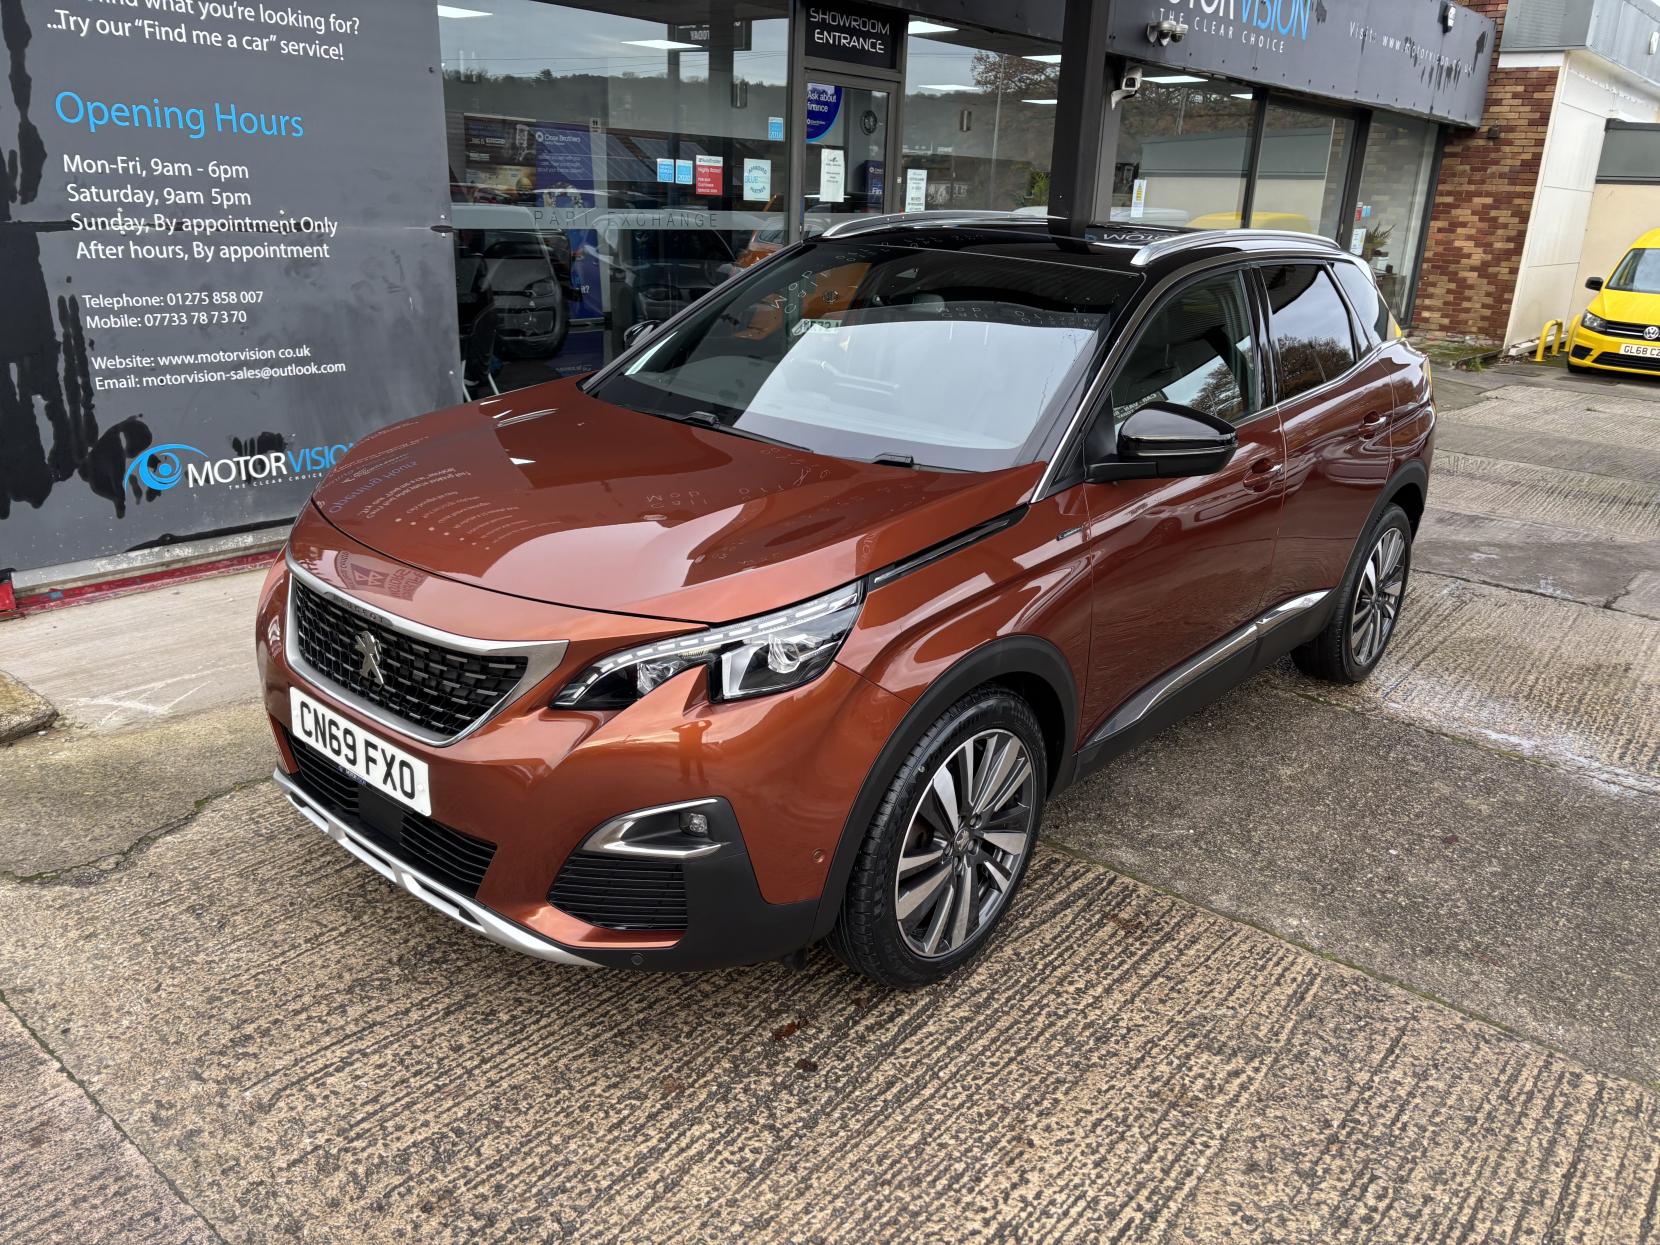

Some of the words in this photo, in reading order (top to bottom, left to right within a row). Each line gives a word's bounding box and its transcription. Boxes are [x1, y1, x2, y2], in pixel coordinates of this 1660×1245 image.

[198, 0, 255, 21] you're
[259, 3, 325, 35] looking
[329, 13, 360, 35] for?
[809, 7, 890, 36] SHOWROOM
[46, 9, 90, 37] ...Try
[95, 19, 131, 37] our
[134, 18, 187, 43] "Find
[192, 30, 222, 47] me
[227, 34, 237, 48] a
[242, 34, 276, 51] car"
[280, 40, 344, 61] service!
[814, 28, 885, 54] ENTRANCE
[1194, 16, 1234, 39] CLEAR
[1241, 30, 1285, 53] CHOICE
[807, 90, 819, 100] Ask
[820, 92, 836, 103] about
[55, 91, 205, 139] Opening
[215, 102, 304, 137] Hours
[63, 153, 147, 178] Mon-Fri,
[150, 158, 193, 177] 9am
[208, 160, 250, 183] 6pm
[66, 183, 160, 208] Saturday,
[163, 187, 205, 205] 9am
[210, 188, 252, 209] 5pm
[70, 212, 149, 236] Sunday,
[153, 213, 178, 236] By
[182, 214, 297, 236] appointment
[300, 216, 338, 238] Only
[534, 210, 589, 227] PART
[607, 211, 718, 228] EXCHANGE
[76, 241, 124, 260] After
[129, 241, 188, 261] hours,
[192, 241, 215, 263] By
[219, 241, 330, 263] appointment
[82, 293, 164, 311] Telephone:
[166, 292, 210, 306] 01275
[212, 291, 238, 305] 858
[240, 291, 264, 304] 007
[86, 314, 142, 329] Mobile:
[144, 313, 188, 327] 07733
[91, 353, 155, 370] Website:
[1624, 345, 1649, 355] GL68
[95, 374, 141, 391] Email:
[143, 361, 347, 388] motorvision-sales@outlook.com
[228, 483, 246, 491] THE
[252, 478, 283, 487] CLEAR
[288, 473, 322, 482] CHOICE
[300, 700, 357, 767] CN69
[364, 738, 416, 801] FXO
